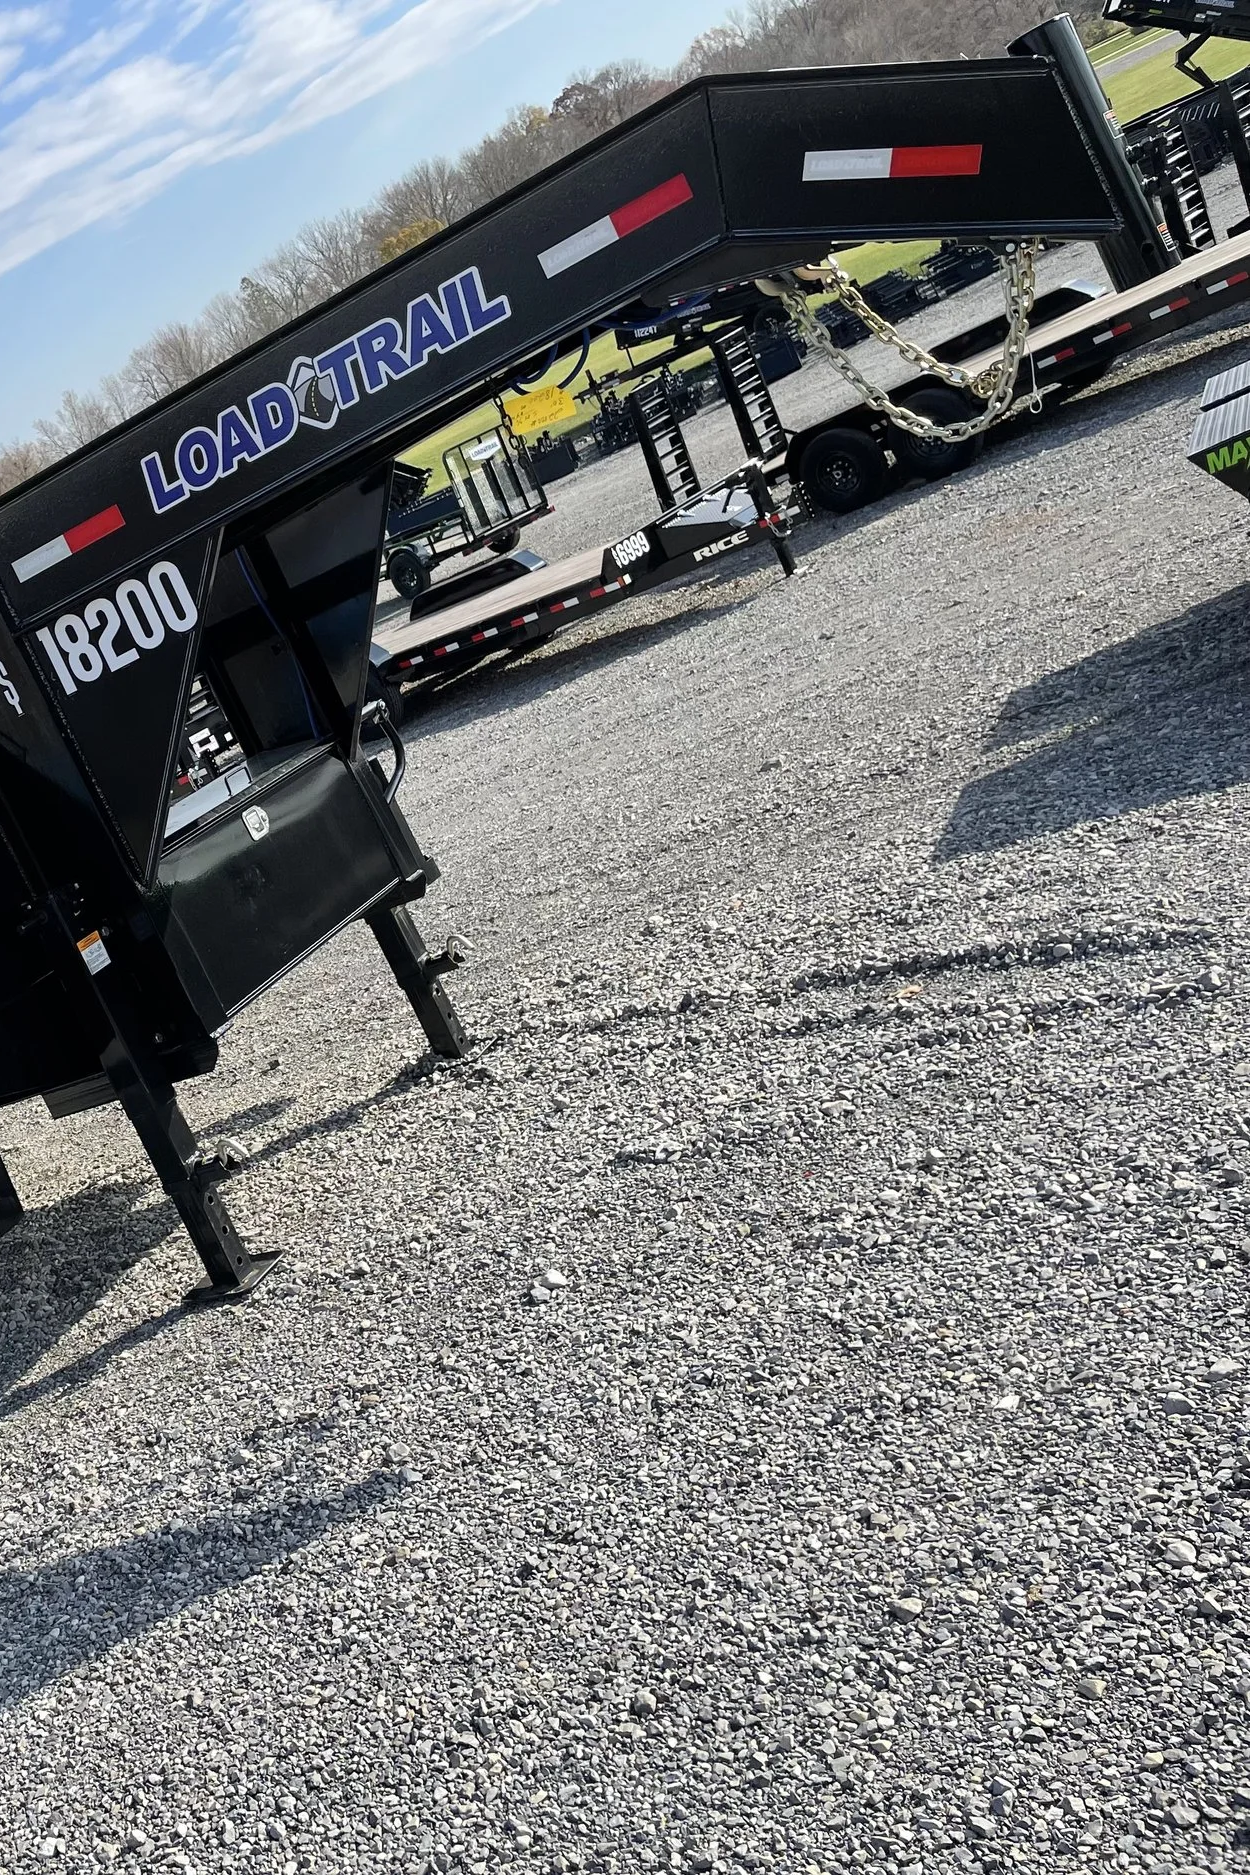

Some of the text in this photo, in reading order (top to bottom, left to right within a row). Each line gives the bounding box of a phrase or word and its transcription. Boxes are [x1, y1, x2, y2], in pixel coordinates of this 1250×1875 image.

[141, 266, 511, 514] LOAD TRAIL
[611, 531, 650, 568] $6999
[693, 529, 750, 562] RICE
[36, 561, 198, 695] 18200
